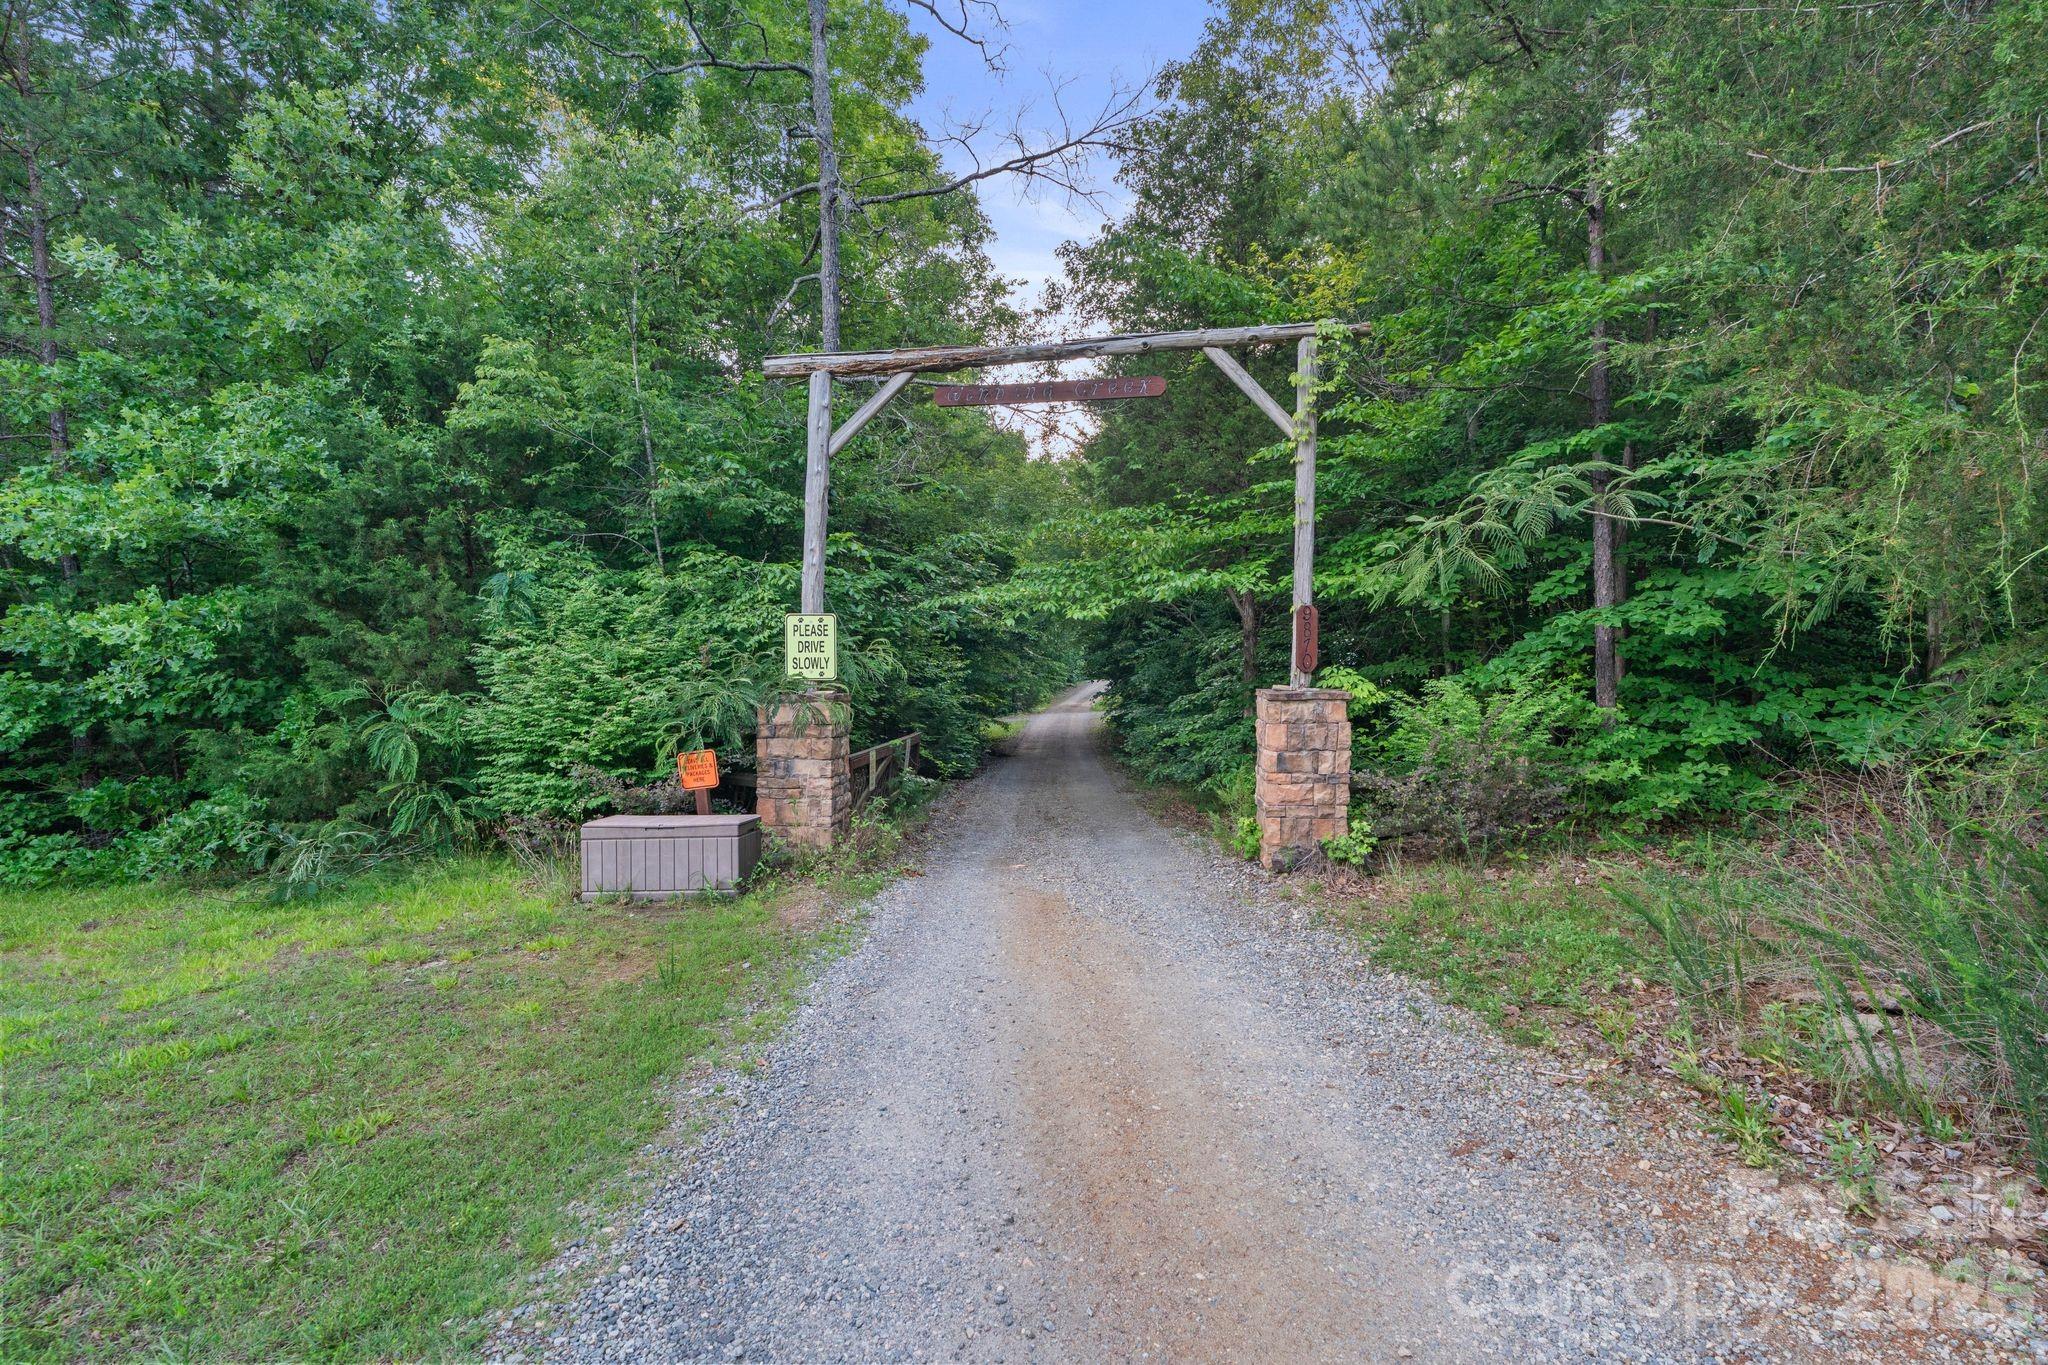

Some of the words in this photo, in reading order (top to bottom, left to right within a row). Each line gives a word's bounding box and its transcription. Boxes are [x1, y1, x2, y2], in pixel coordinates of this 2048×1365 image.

[793, 625, 828, 636] PLEASE
[1303, 606, 1312, 669] 9870
[798, 641, 825, 653] DRIVE
[792, 657, 830, 669] SLOWLY
